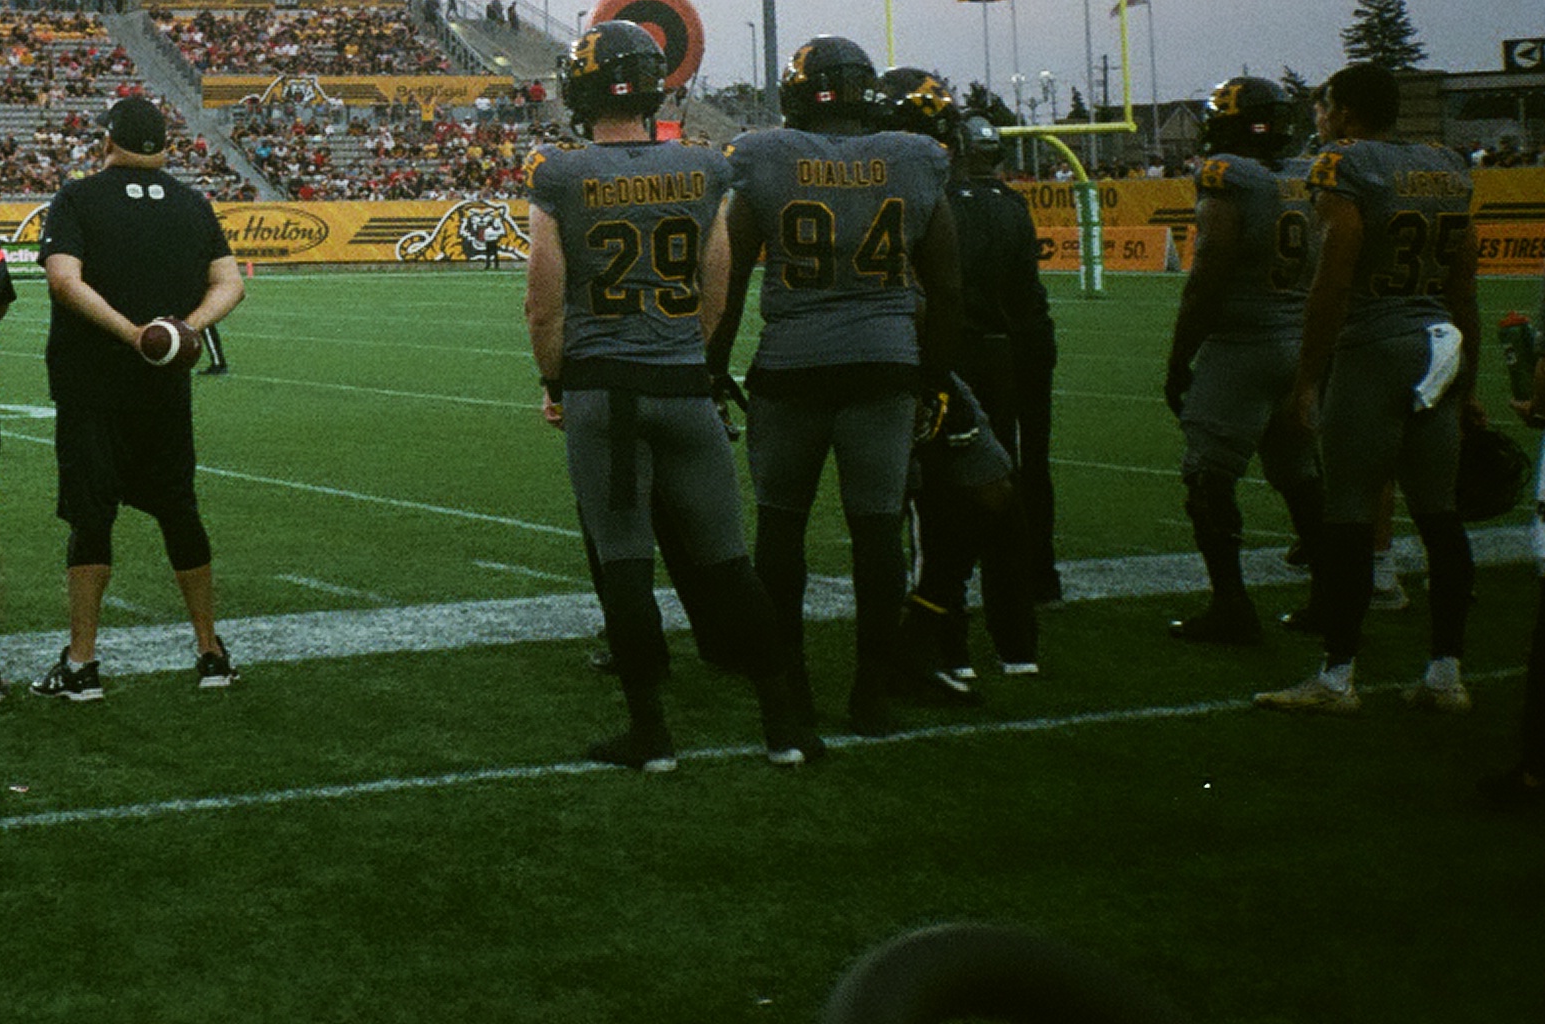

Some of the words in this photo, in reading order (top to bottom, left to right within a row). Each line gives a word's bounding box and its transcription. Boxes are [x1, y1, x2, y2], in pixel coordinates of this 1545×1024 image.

[796, 159, 886, 188] DIALLO
[243, 215, 326, 241] Hortons
[779, 197, 907, 291] 94
[586, 215, 702, 318] 29
